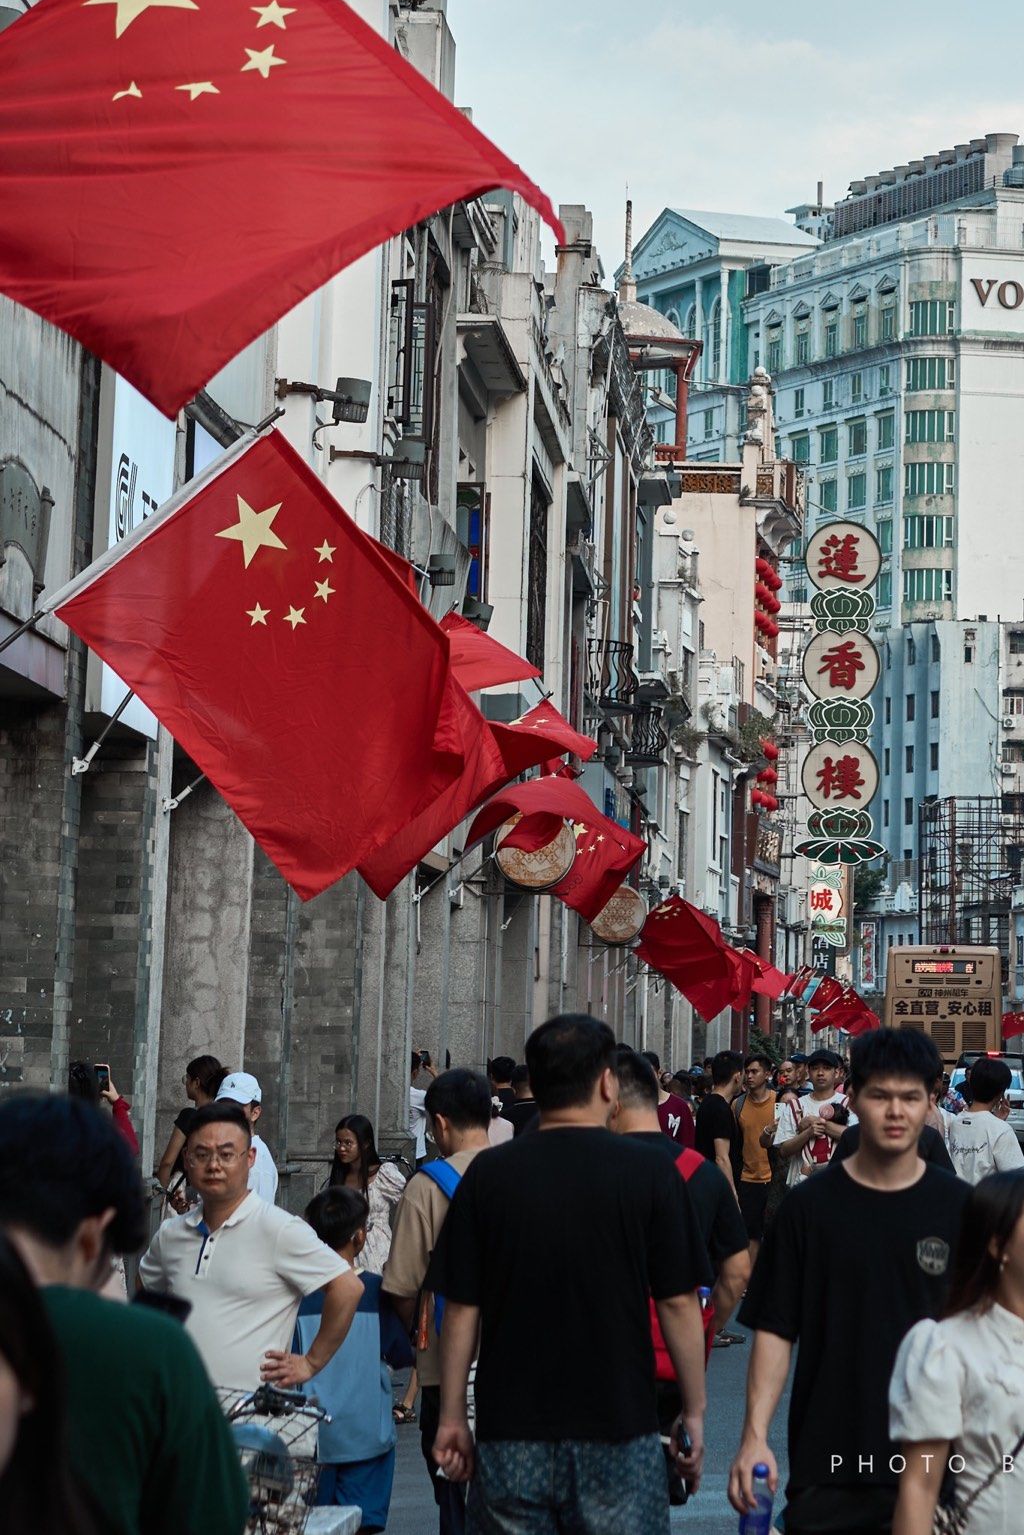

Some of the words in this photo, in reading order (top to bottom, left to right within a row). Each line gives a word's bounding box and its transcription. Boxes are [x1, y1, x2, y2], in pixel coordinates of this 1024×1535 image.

[817, 533, 867, 800] 蓮香樓
[810, 888, 833, 911] 城
[895, 1000, 940, 1016] 全直营
[947, 1001, 992, 1016] 安心租
